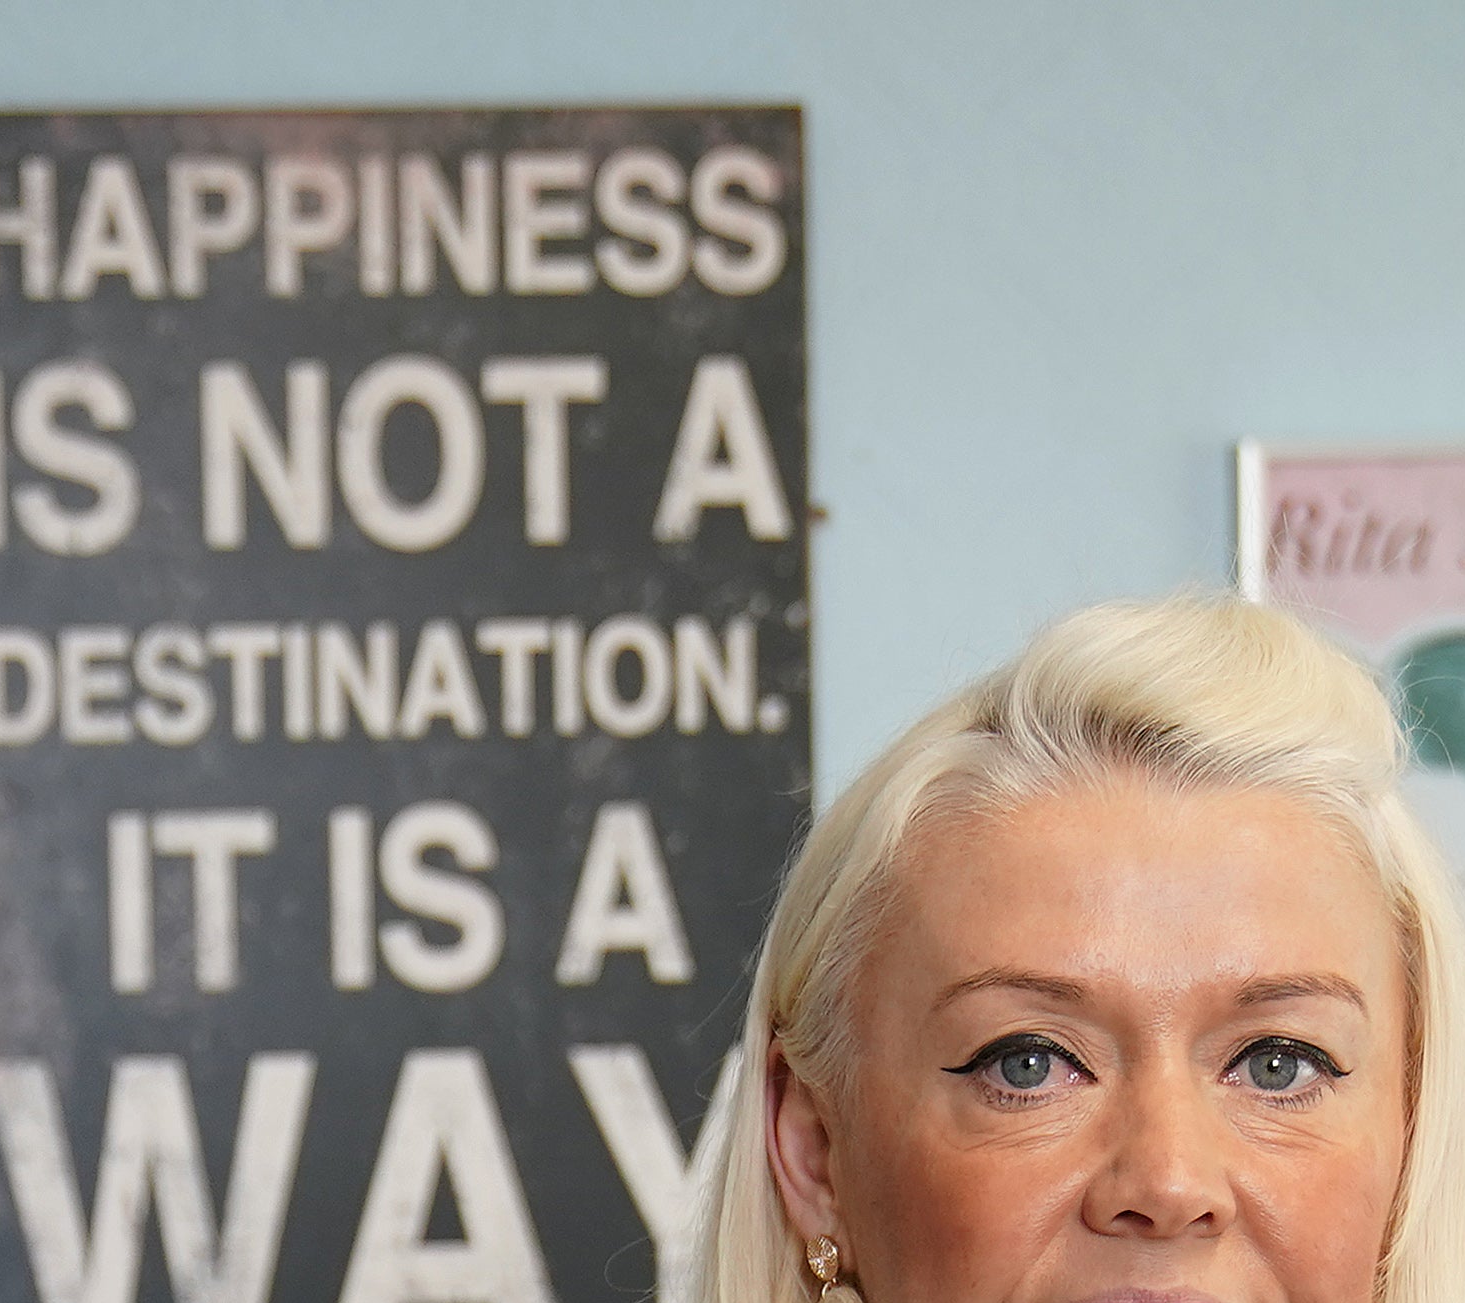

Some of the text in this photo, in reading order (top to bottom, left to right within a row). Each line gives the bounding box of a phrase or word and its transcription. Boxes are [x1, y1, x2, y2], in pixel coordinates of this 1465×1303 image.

[198, 352, 609, 554] NOT
[652, 353, 795, 542] A
[1267, 490, 1436, 583] Rita
[106, 801, 698, 995] IT IS A
